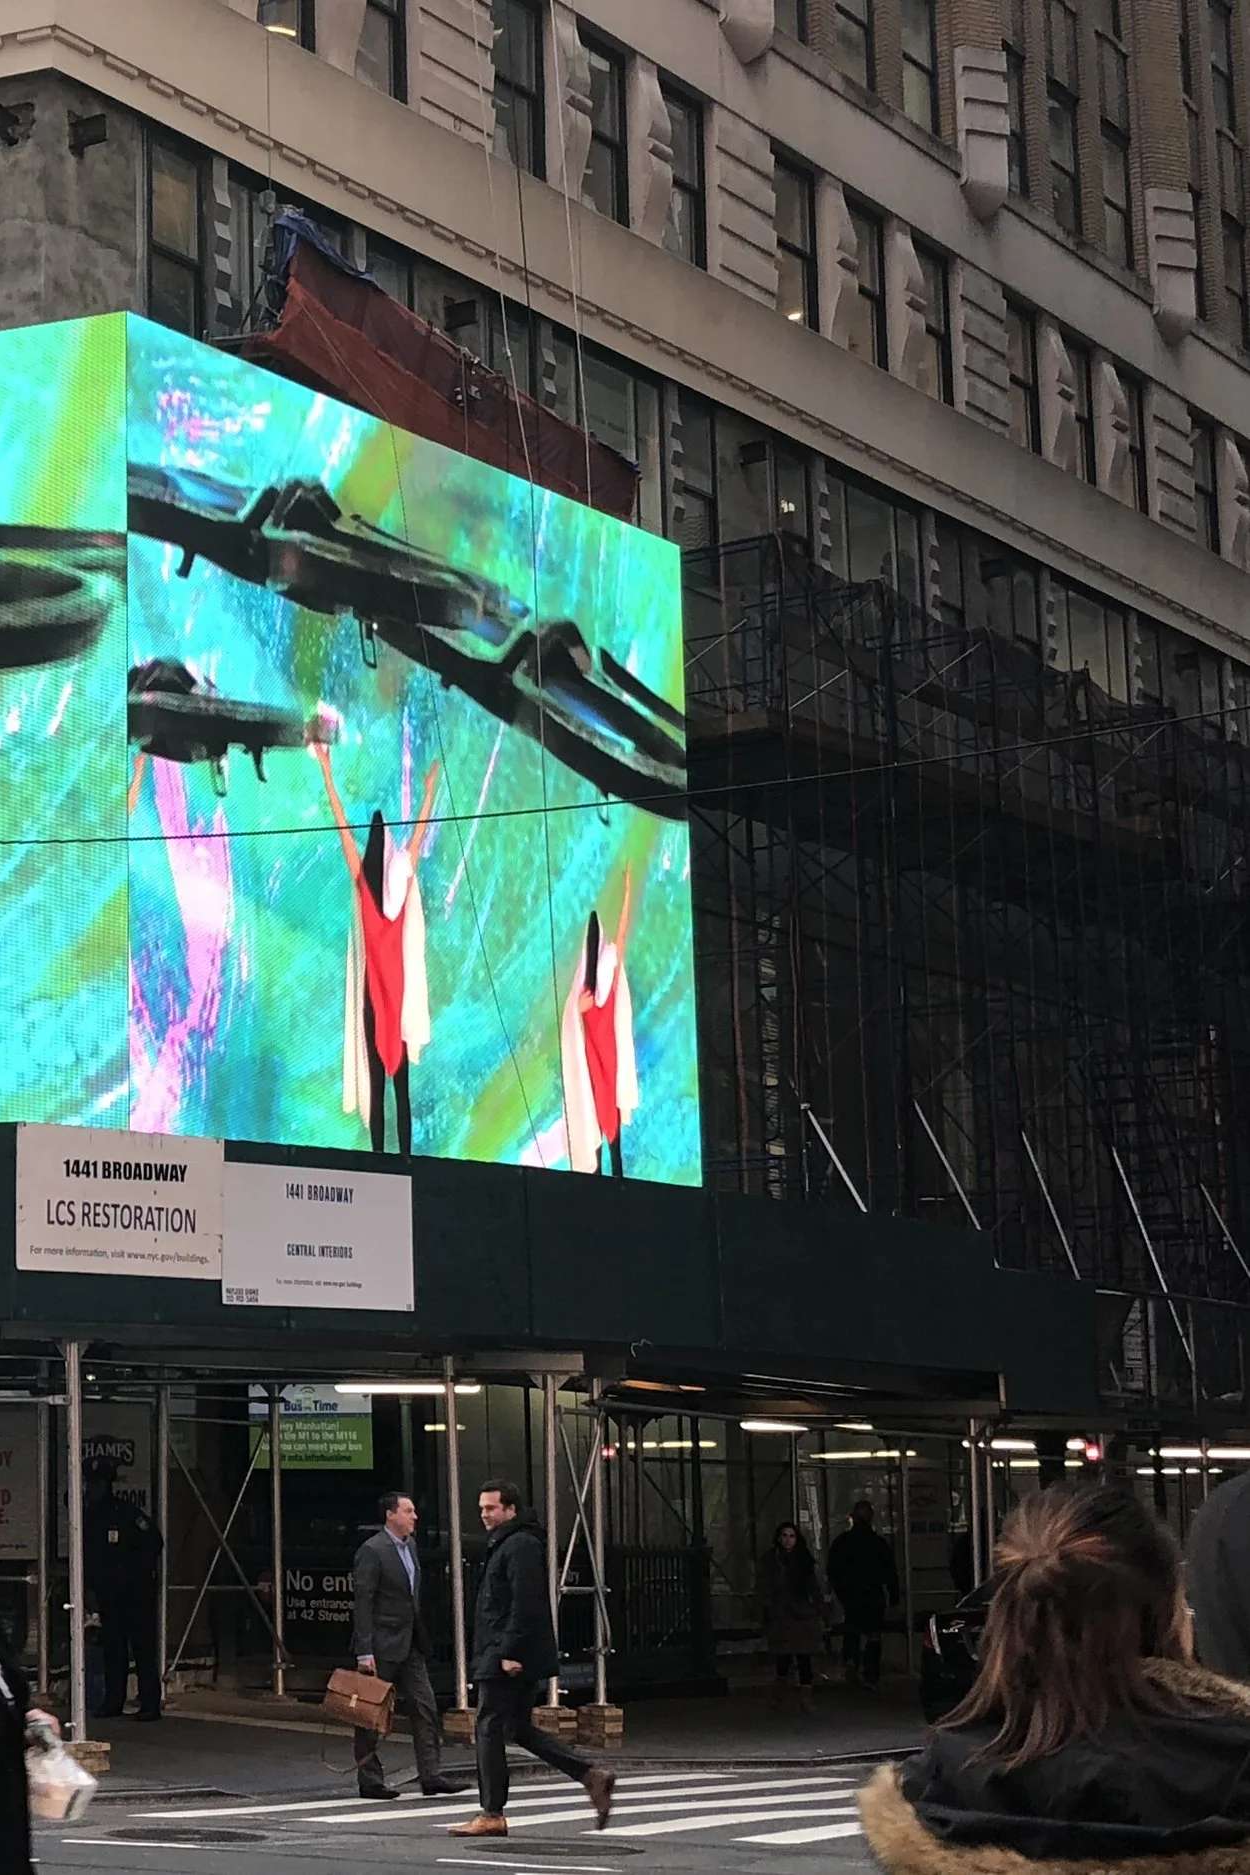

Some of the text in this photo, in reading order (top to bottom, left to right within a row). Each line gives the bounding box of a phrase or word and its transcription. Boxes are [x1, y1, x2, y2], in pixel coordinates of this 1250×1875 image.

[63, 1159, 188, 1183] 1441 BROADWAY
[286, 1183, 354, 1204] 1441 BROADWAY
[47, 1199, 196, 1234] LCS RESTORATION
[30, 1245, 42, 1255] For
[44, 1247, 63, 1256] more
[65, 1246, 109, 1259] information,
[111, 1249, 125, 1259] visit
[287, 1243, 353, 1260] CENTRAL INTERIORS
[284, 1400, 338, 1412] Bus Time
[295, 1421, 340, 1431] Manhattan!
[298, 1431, 310, 1440] M1
[322, 1431, 334, 1440] the
[82, 1442, 135, 1464] HAMPS
[329, 1442, 347, 1452] your
[348, 1441, 362, 1451] bus
[286, 1570, 354, 1592] No ent
[286, 1596, 355, 1610] Use entrance
[287, 1609, 350, 1622] at 42 Street
